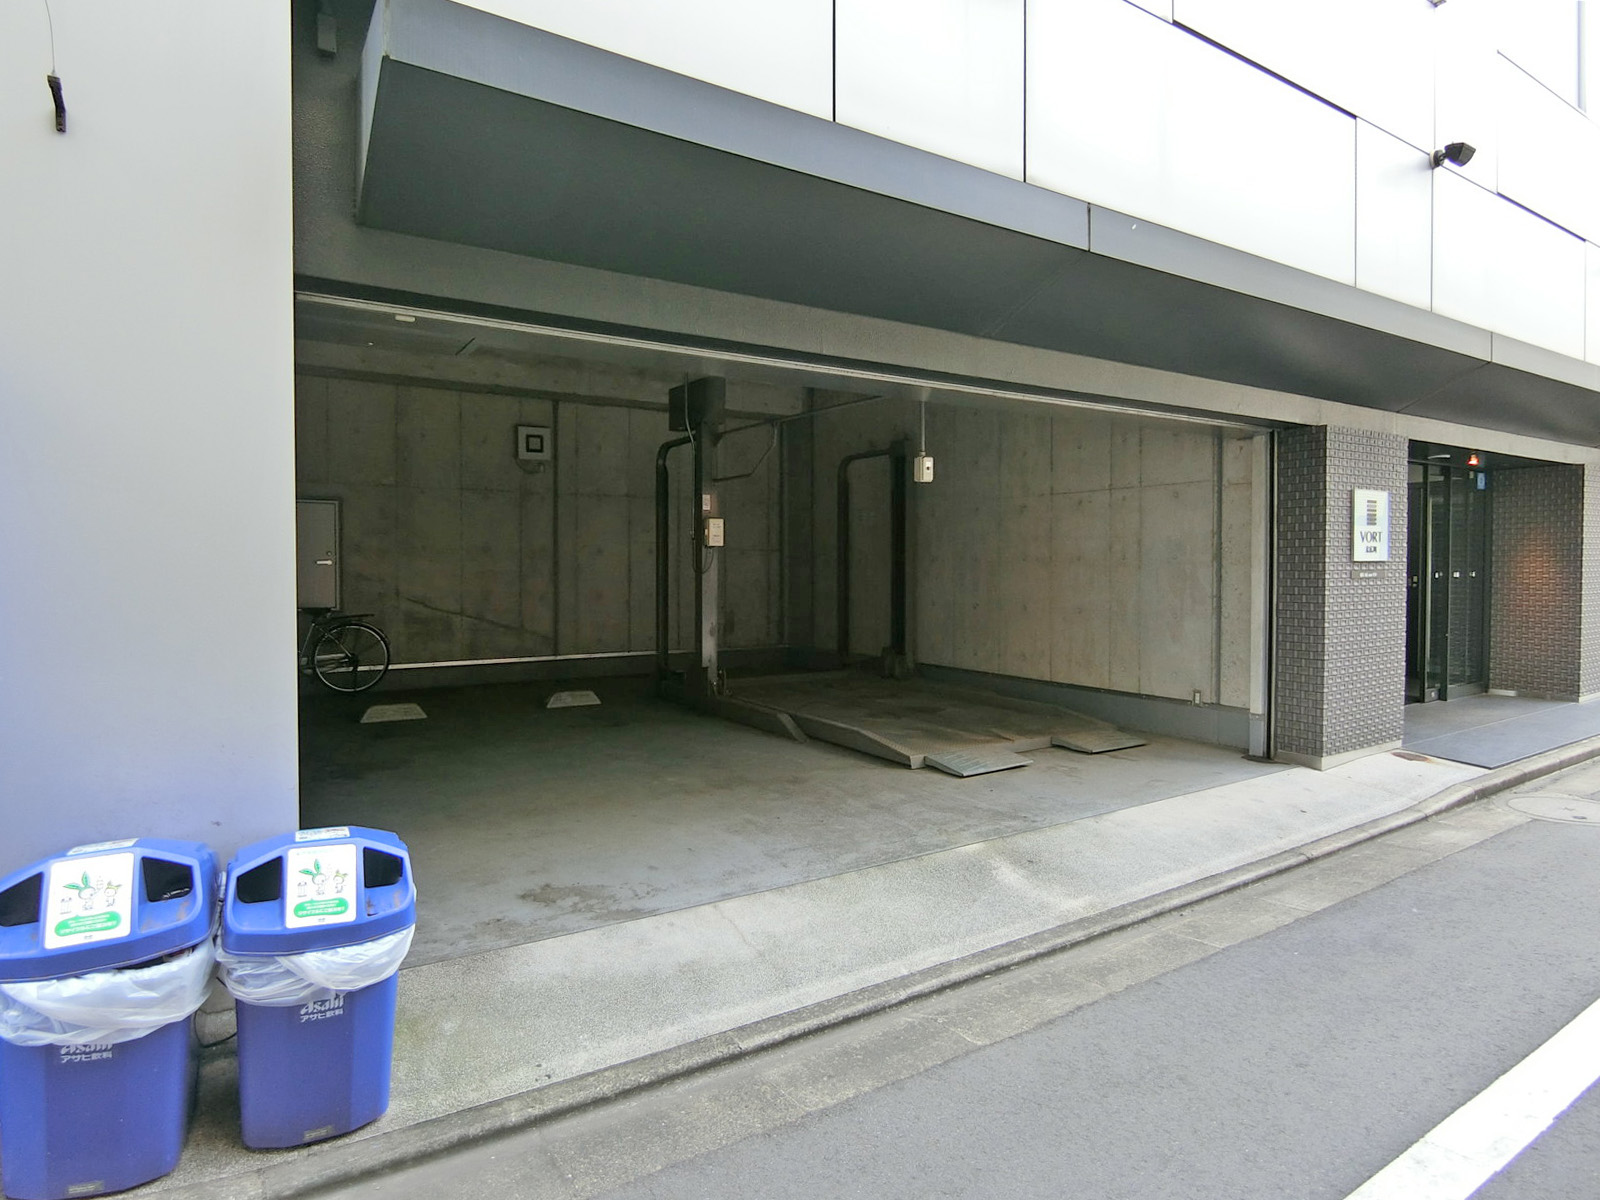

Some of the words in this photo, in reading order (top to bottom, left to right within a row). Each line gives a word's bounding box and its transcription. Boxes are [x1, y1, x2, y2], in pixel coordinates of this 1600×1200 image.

[1360, 531, 1382, 543] VORT
[300, 1008, 344, 1023] アサヒ飲料
[60, 1051, 113, 1063] アサヒ飲料
